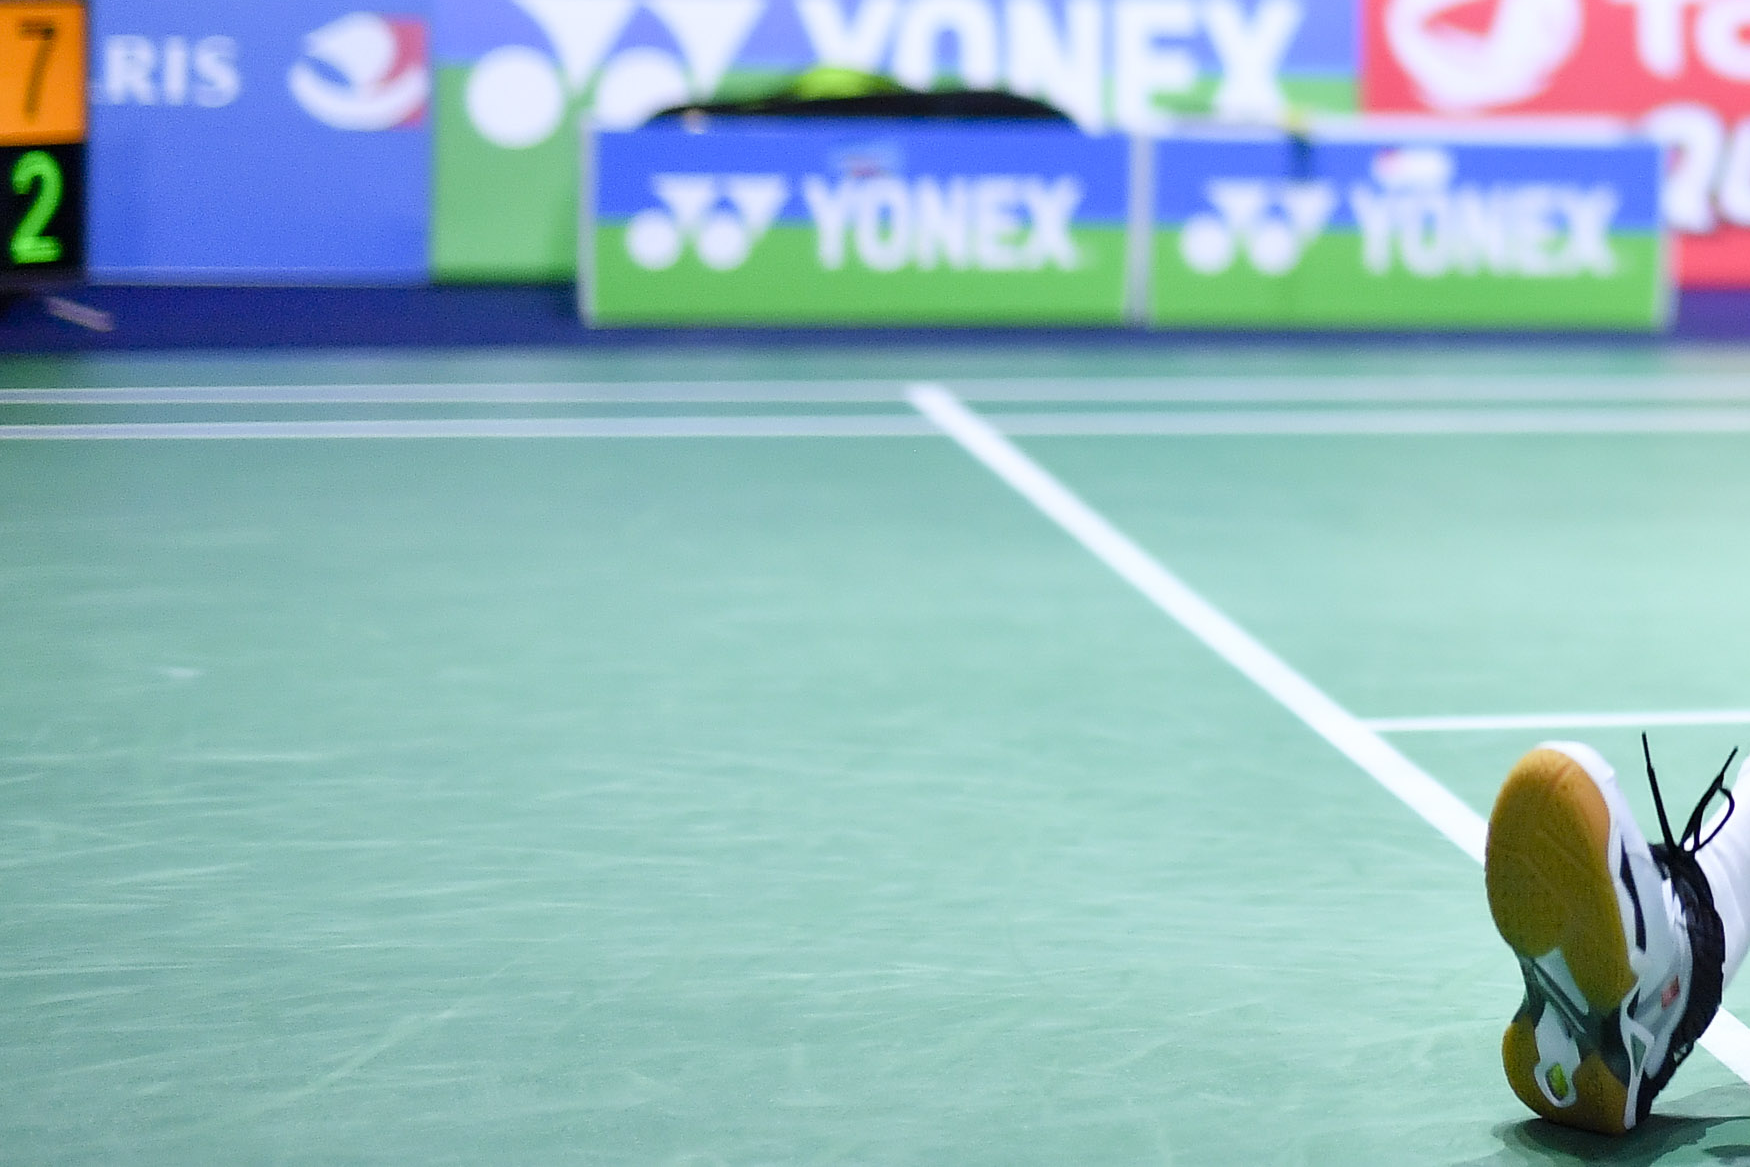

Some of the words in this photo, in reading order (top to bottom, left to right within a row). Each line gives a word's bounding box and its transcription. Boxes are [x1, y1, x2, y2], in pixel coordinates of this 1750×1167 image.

[19, 18, 57, 124] 7
[92, 33, 242, 107] RIS
[10, 150, 64, 265] 2
[803, 173, 1082, 272] YONEX
[1350, 181, 1620, 276] YONEX
